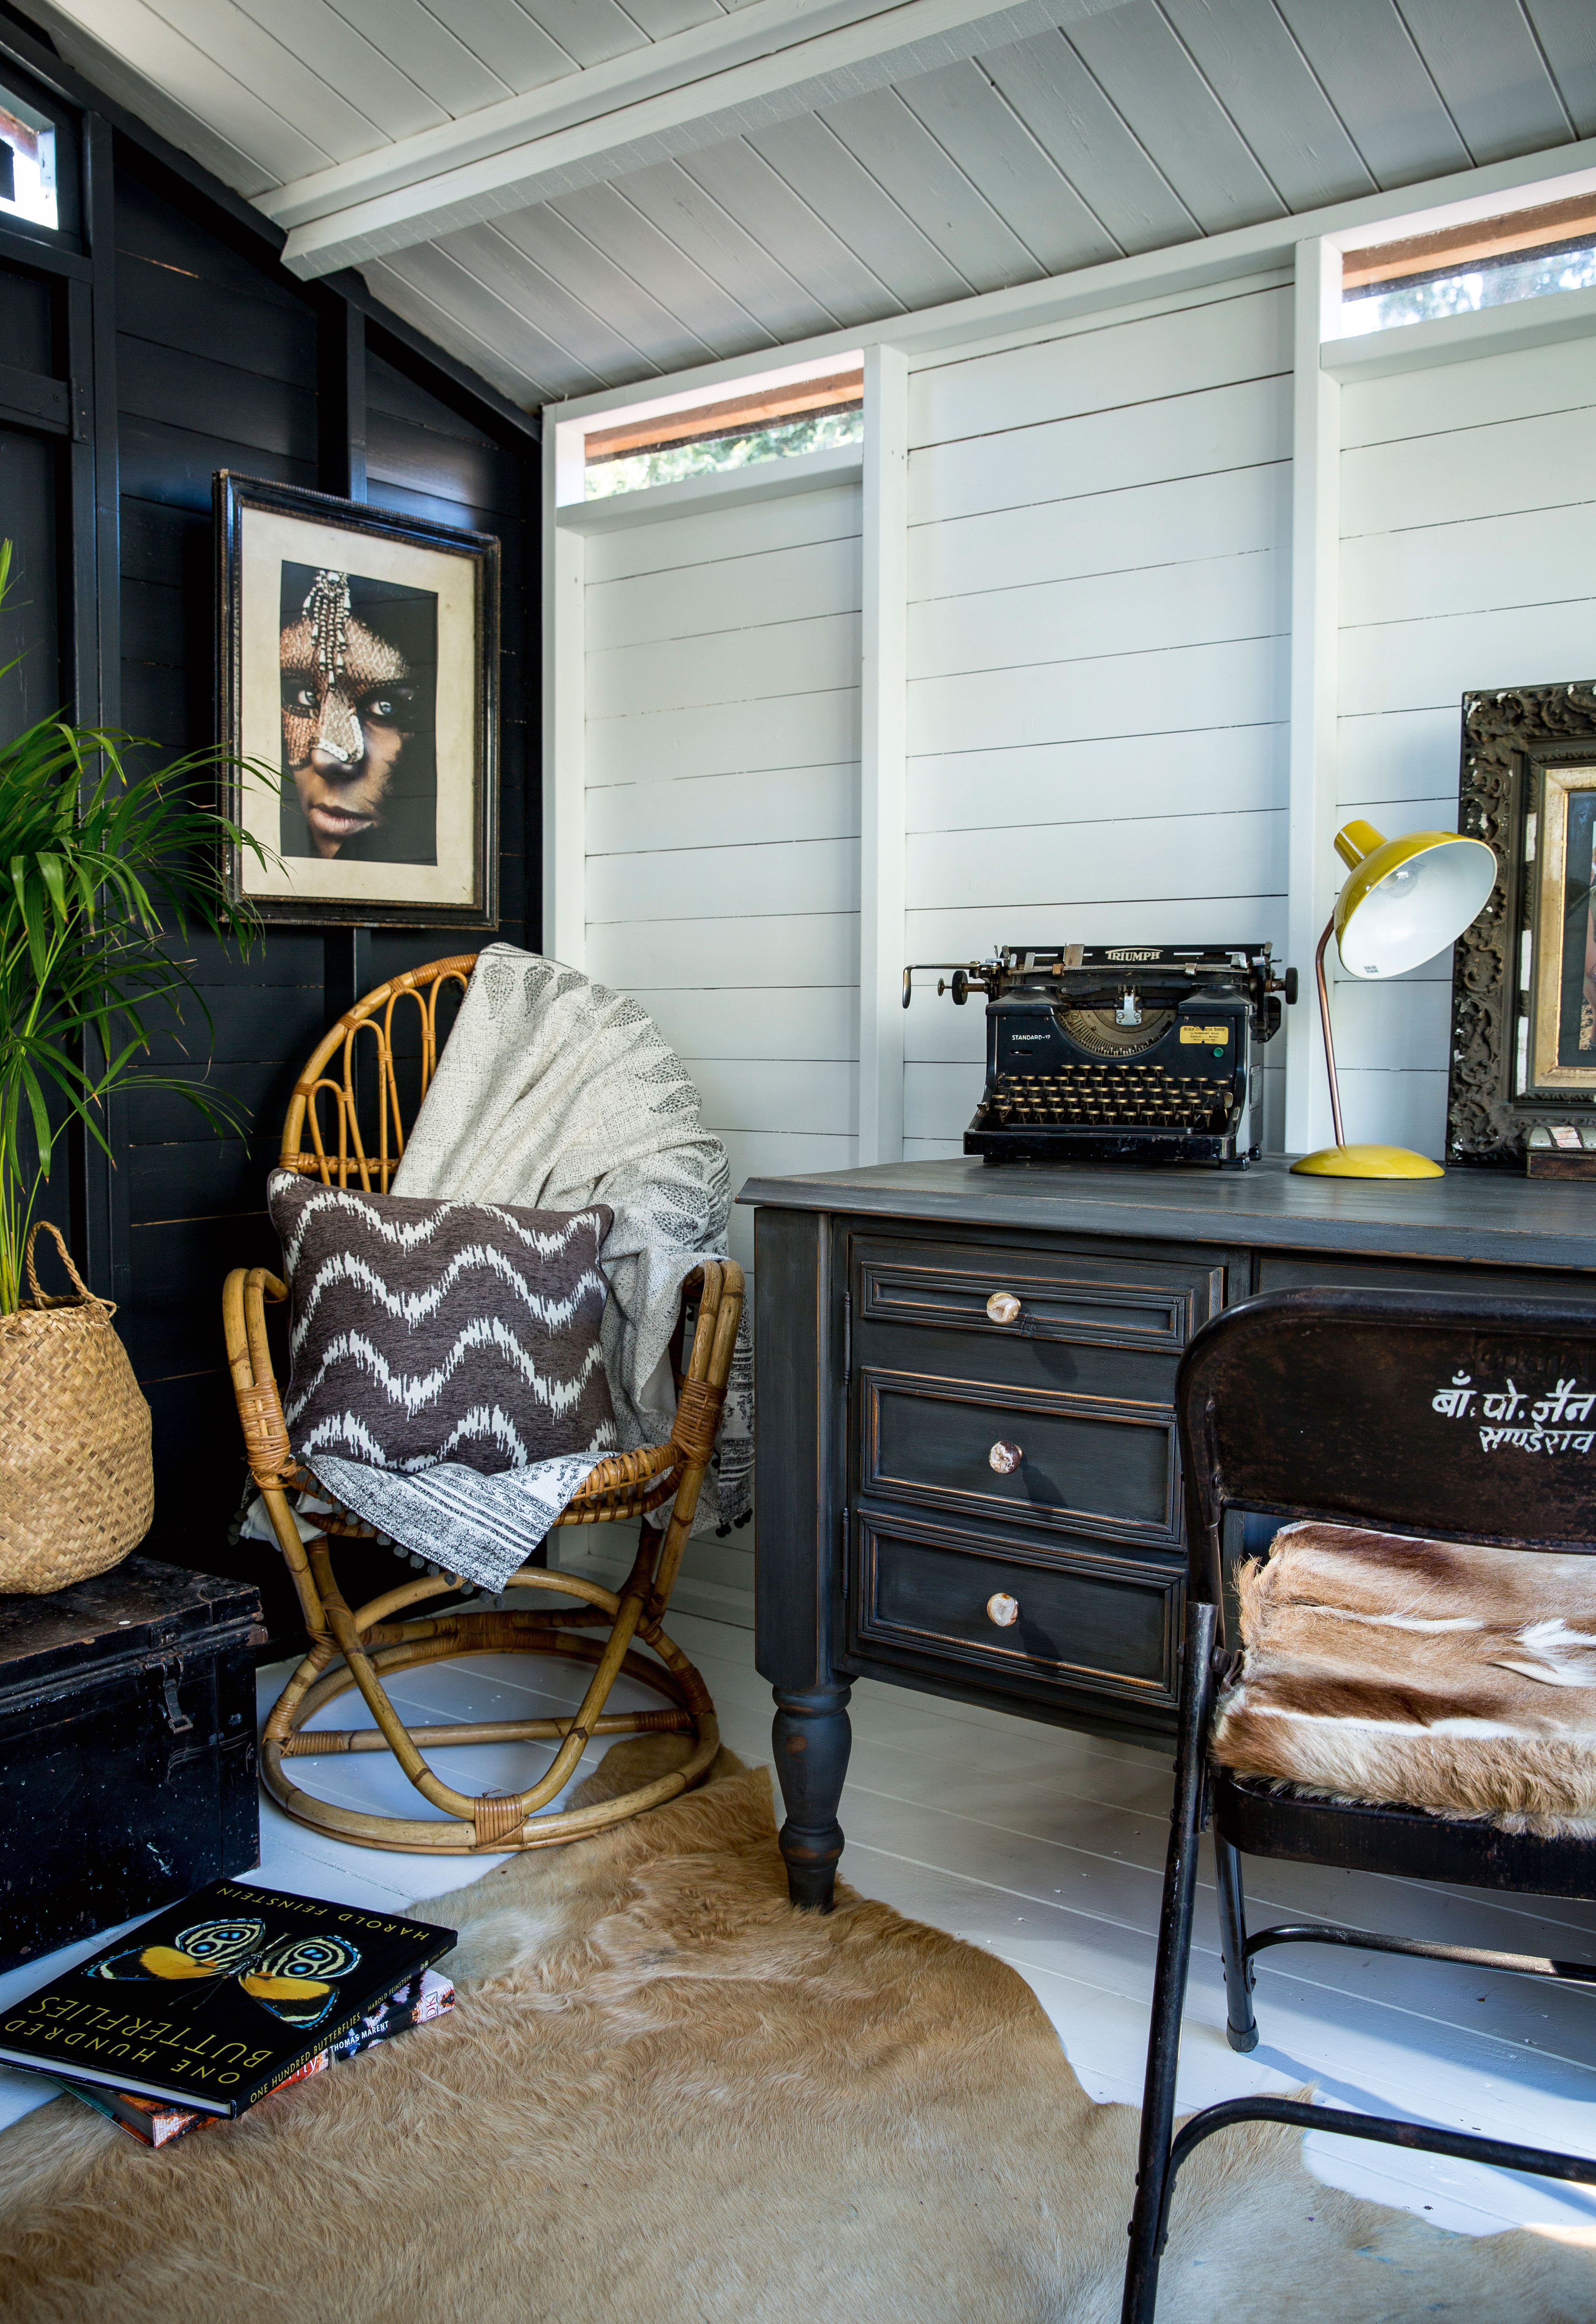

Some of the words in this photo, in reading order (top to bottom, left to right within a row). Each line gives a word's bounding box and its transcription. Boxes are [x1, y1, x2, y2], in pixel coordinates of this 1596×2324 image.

[1105, 948, 1164, 961] TRIUMPH
[217, 1887, 328, 1915] FEINSTEIN
[338, 1914, 430, 1940] HAROLD
[368, 1993, 387, 2012] HAROLD
[389, 1973, 412, 1995] FEINSTEIN
[426, 1994, 436, 2019] DK
[5, 2020, 157, 2063] HUNDRED
[28, 1997, 273, 2068] BUTTERFLIES
[329, 2034, 360, 2052] THOMAS
[361, 2020, 389, 2039] MARENT
[171, 2059, 240, 2084] ONE
[251, 2083, 268, 2103] ONE
[271, 2051, 310, 2088] HUNDRED
[313, 2012, 360, 2055] BUTTERFLIES
